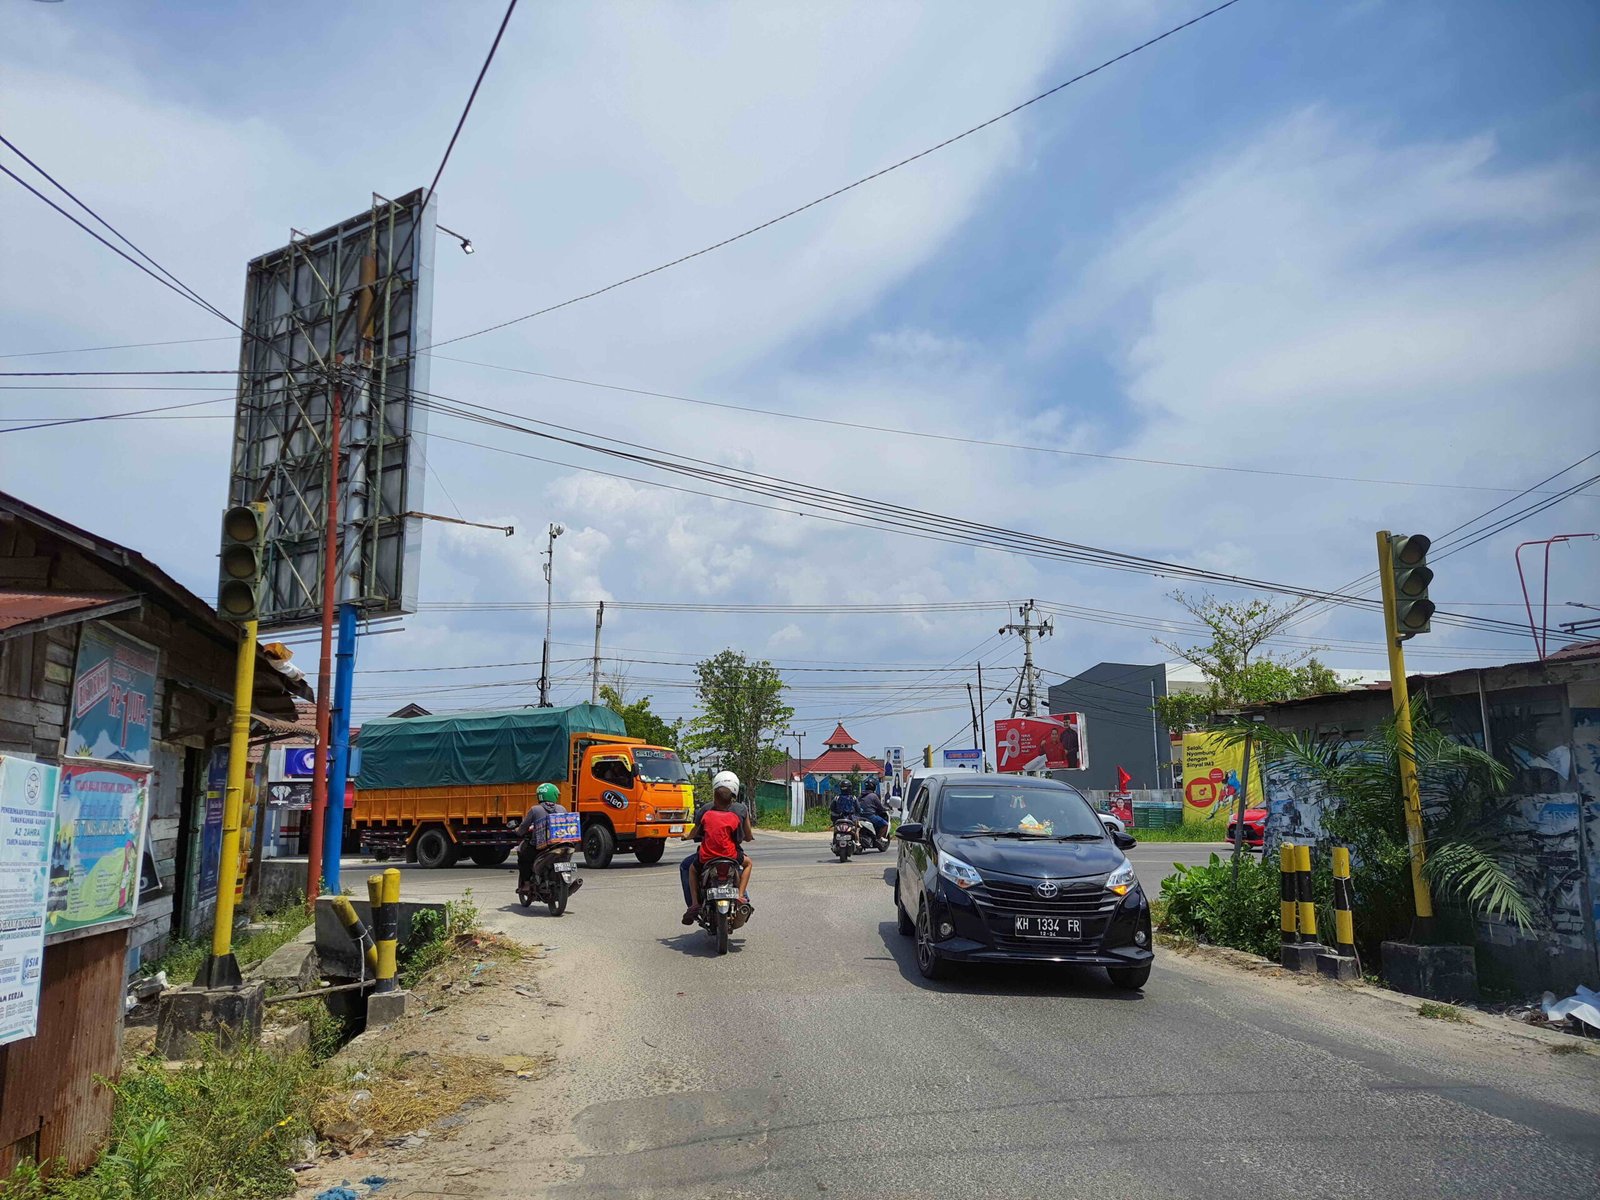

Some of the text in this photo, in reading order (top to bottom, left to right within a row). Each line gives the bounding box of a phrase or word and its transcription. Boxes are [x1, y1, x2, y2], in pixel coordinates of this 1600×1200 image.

[998, 728, 1020, 767] 78
[605, 792, 623, 809] Cleo
[23, 828, 40, 837] ZAHRA
[1016, 917, 1080, 932] KH 1334 FR
